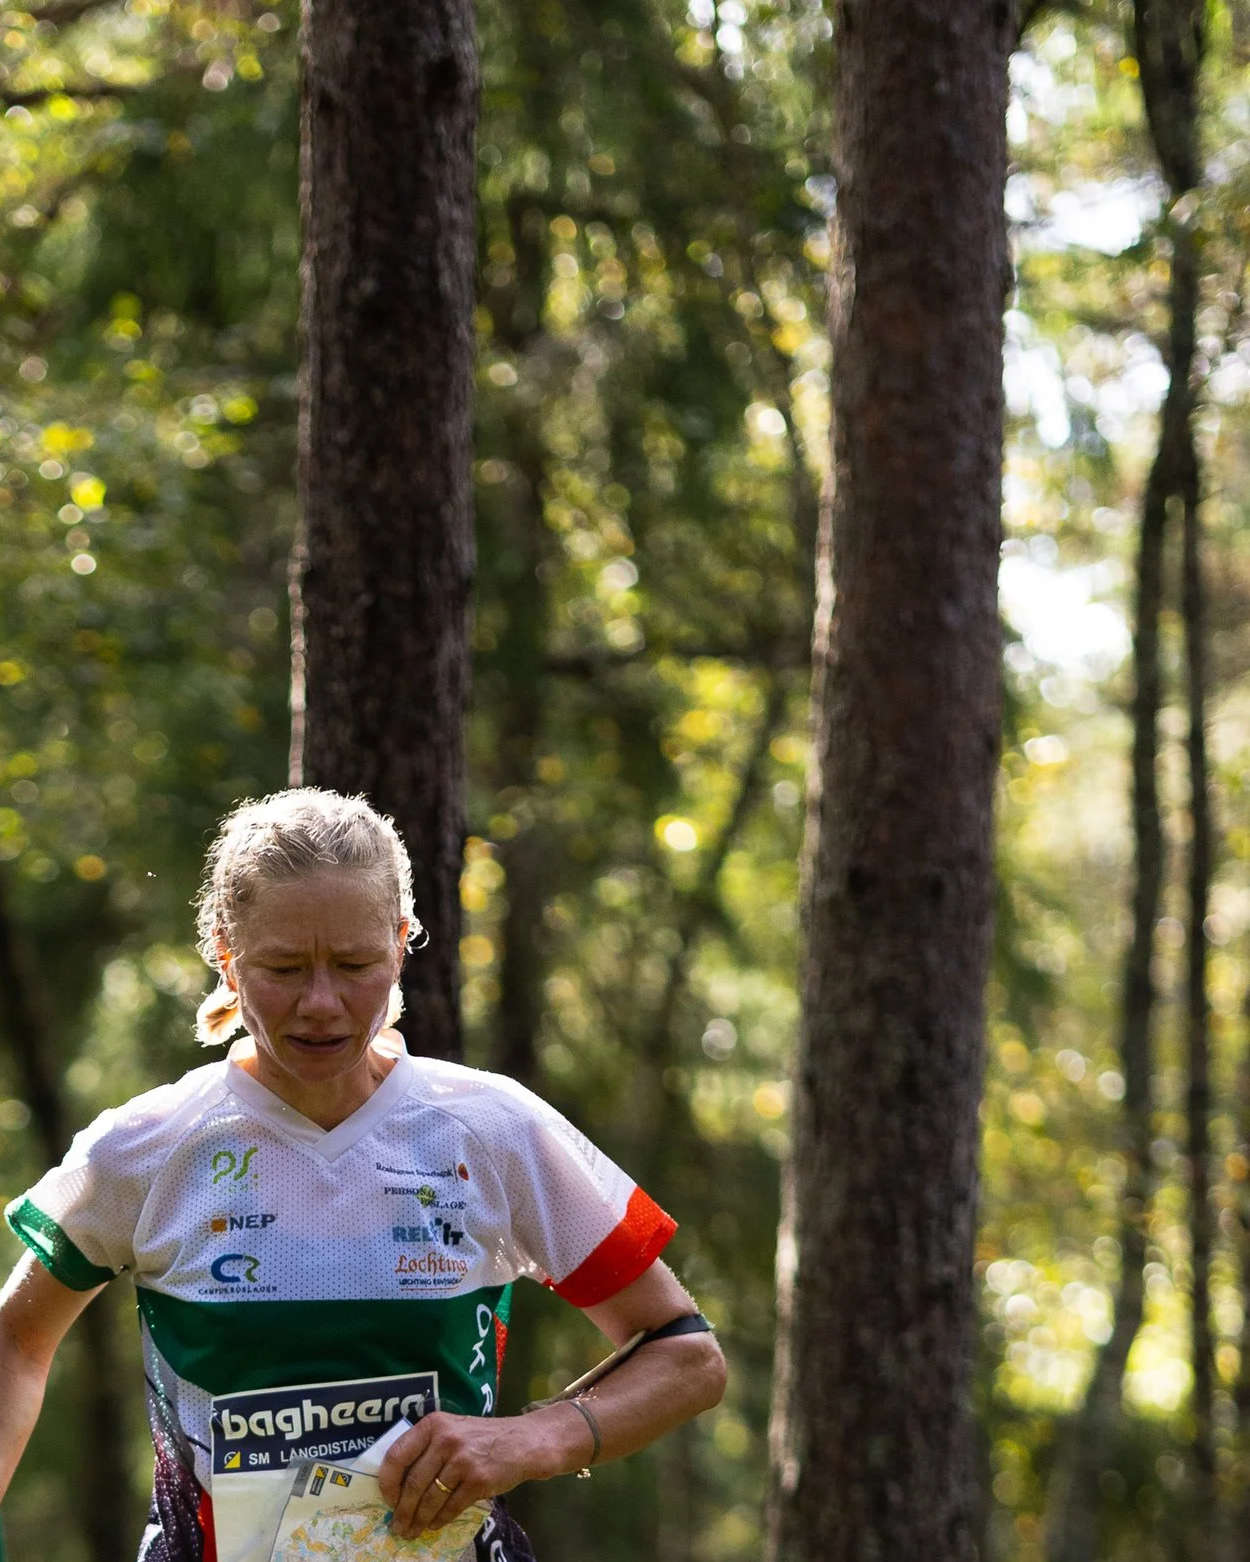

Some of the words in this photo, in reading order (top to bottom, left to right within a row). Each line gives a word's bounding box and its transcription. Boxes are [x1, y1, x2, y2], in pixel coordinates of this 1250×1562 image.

[229, 1213, 276, 1232] NEP
[221, 1393, 424, 1440] bagheera
[248, 1452, 270, 1466] SM
